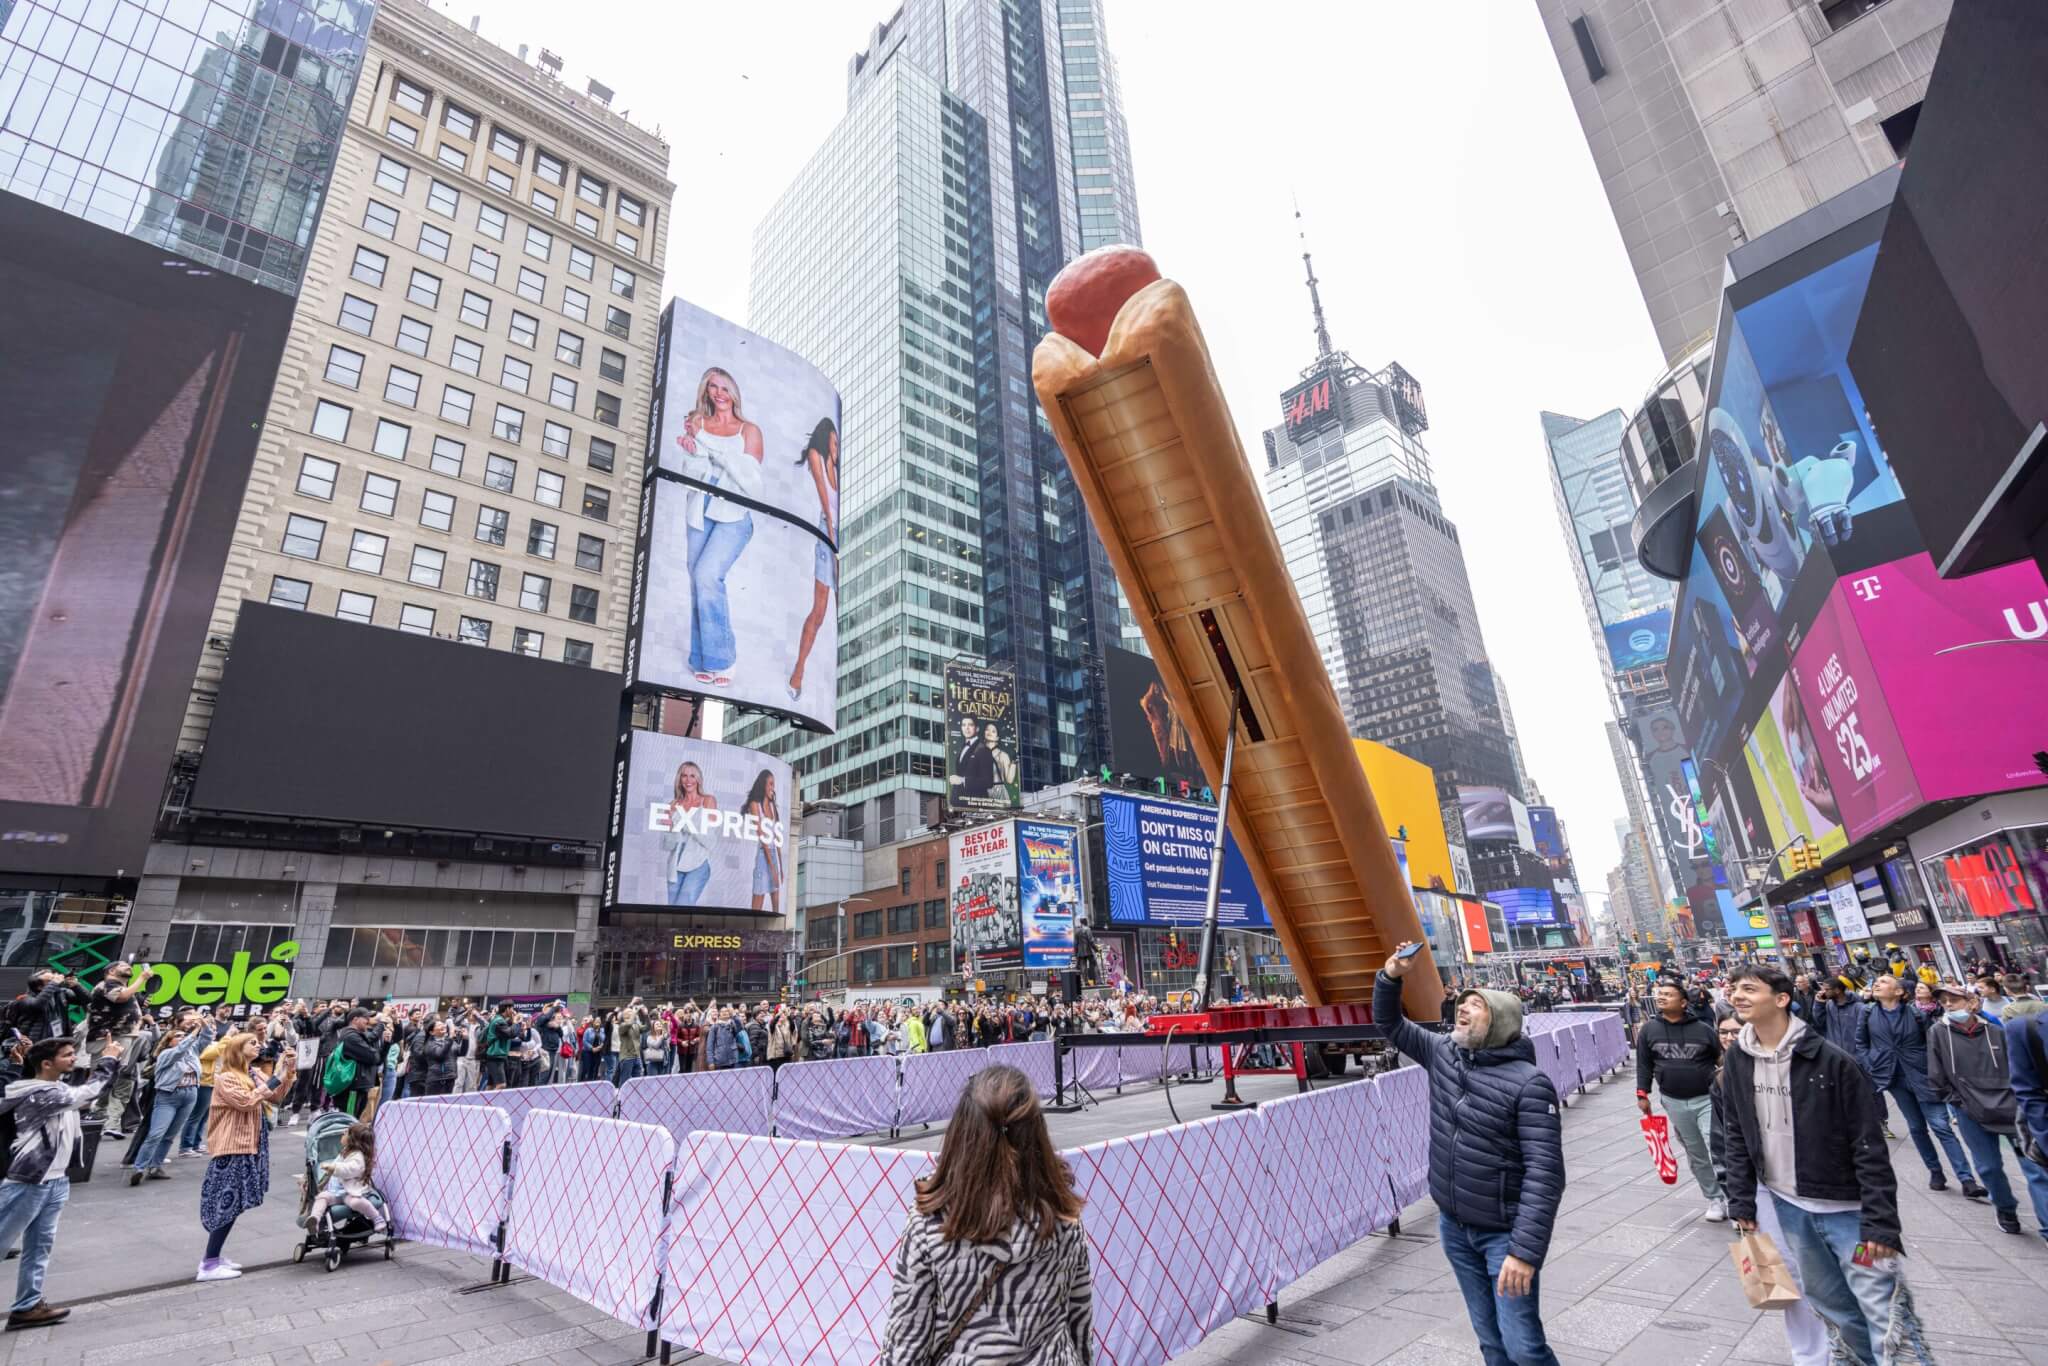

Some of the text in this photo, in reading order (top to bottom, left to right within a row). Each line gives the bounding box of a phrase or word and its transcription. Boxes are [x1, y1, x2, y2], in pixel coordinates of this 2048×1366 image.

[1288, 379, 1329, 430] H&M
[631, 551, 645, 626] EXPRESS
[2003, 599, 2048, 640] U
[973, 688, 1010, 706] GREAT
[1821, 675, 1858, 731] UNLIMITED
[611, 760, 625, 837] EXPRESS
[1141, 804, 1172, 817] AMERICAN
[648, 802, 785, 848] EXPRESS
[1141, 820, 1175, 838] DON'T
[1177, 826, 1203, 841] MISS
[964, 827, 1005, 846] BEST OF
[960, 838, 1009, 858] THE YEAR!
[1143, 839, 1160, 855] ON
[1162, 842, 1209, 861] GETTING
[1894, 908, 1923, 928] SEPHORA
[674, 936, 742, 949] EXPRESS
